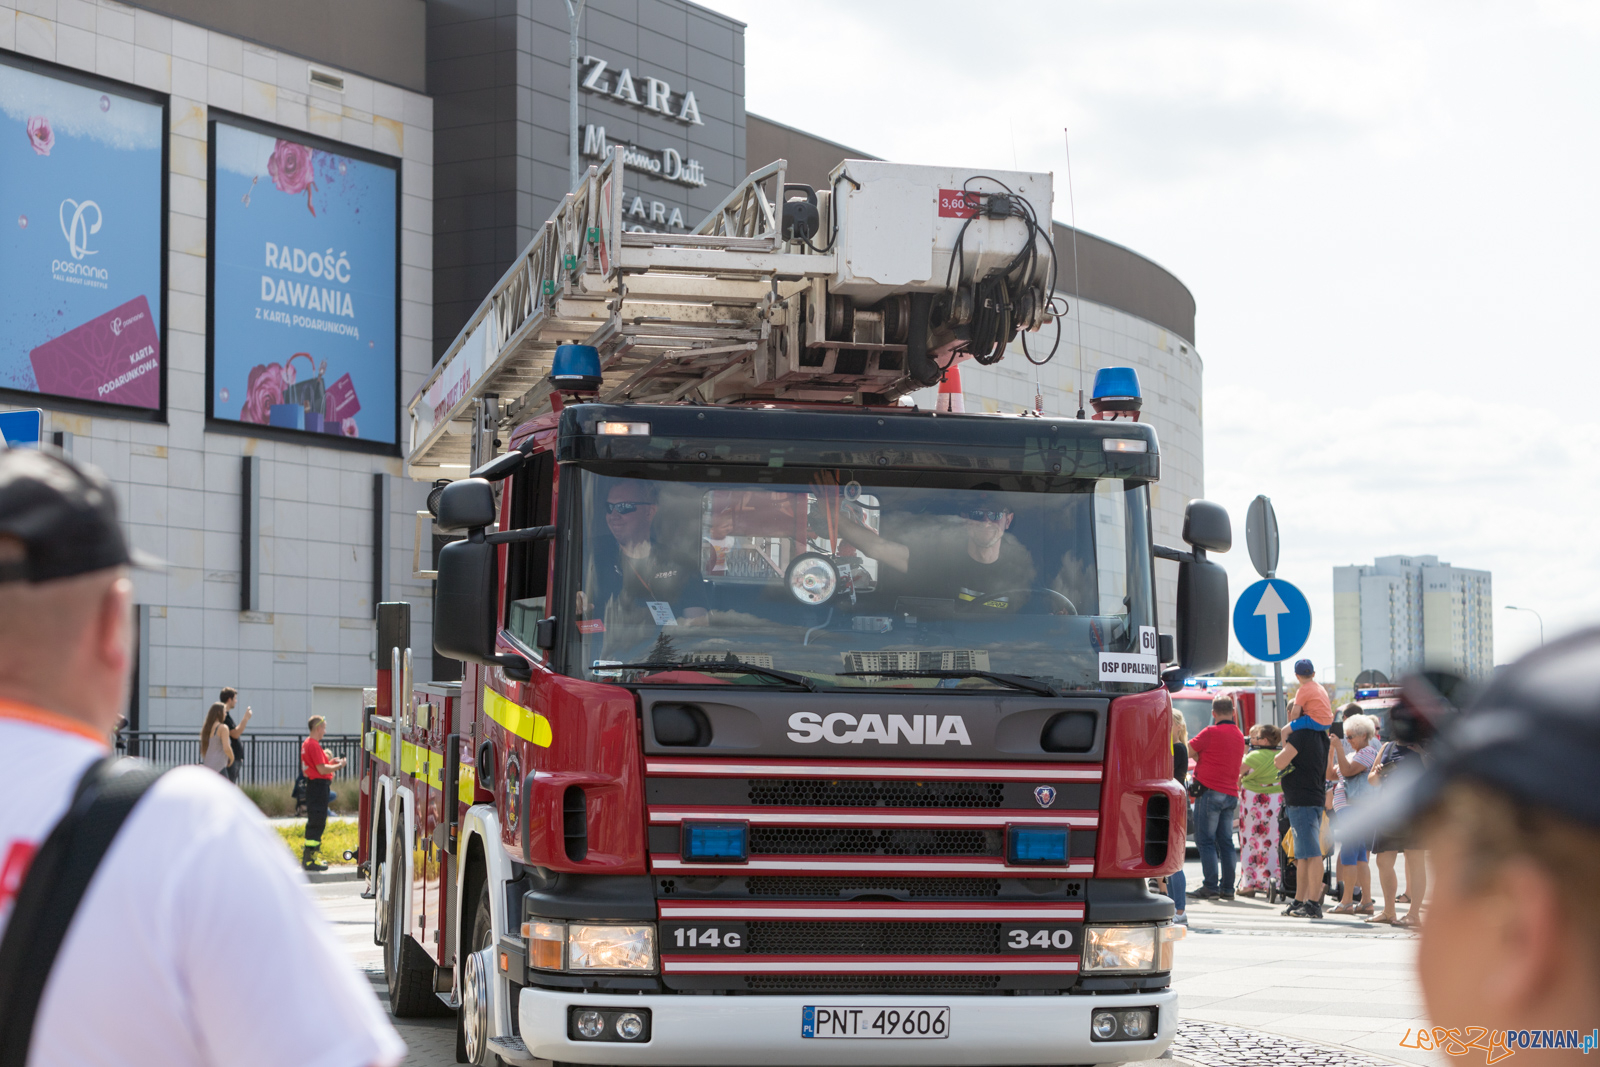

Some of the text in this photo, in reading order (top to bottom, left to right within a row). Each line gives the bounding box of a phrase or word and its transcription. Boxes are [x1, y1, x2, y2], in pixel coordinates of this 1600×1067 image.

[582, 55, 705, 126] ZARA
[583, 124, 707, 187] Masimo Dutti
[622, 192, 685, 229] ARA
[941, 198, 965, 209] 3,60
[52, 259, 108, 280] posnania
[265, 241, 351, 284] RADOŚĆ
[261, 275, 355, 319] DAWANIA
[255, 307, 360, 341] Z KARTĄ PODARUNKOWĄ
[129, 345, 154, 365] KARTA
[97, 358, 158, 398] PODARUNKOWA
[1142, 631, 1155, 650] 60
[1101, 661, 1120, 674] OSP
[787, 711, 972, 745] SCANIA
[1007, 929, 1073, 949] 340
[804, 1025, 813, 1033] PL
[816, 1009, 946, 1035] PNT 49606
